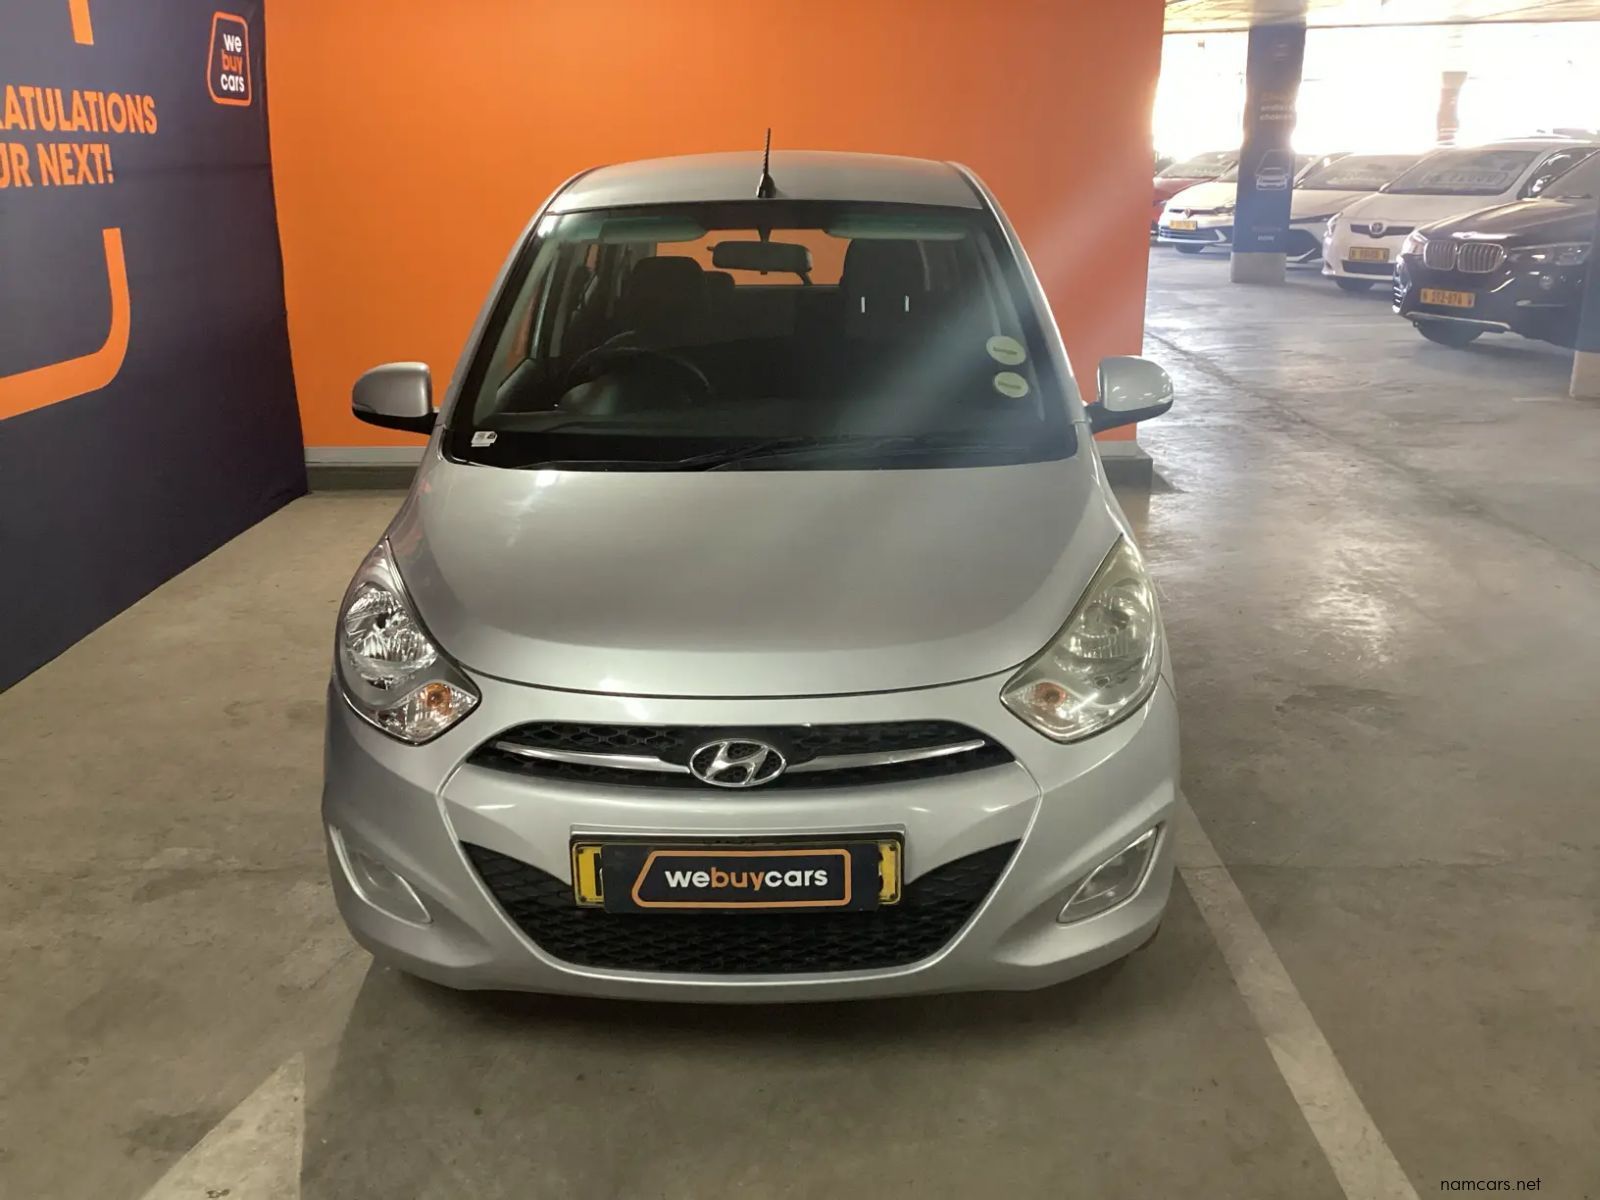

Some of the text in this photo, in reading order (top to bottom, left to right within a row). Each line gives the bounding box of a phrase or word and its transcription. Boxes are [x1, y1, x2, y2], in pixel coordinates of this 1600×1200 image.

[222, 32, 243, 53] we
[221, 48, 243, 76] buy
[220, 73, 245, 93] cars
[0, 85, 158, 135] ATULATIONS
[36, 143, 115, 187] NEXT!
[664, 867, 828, 891] webuycars
